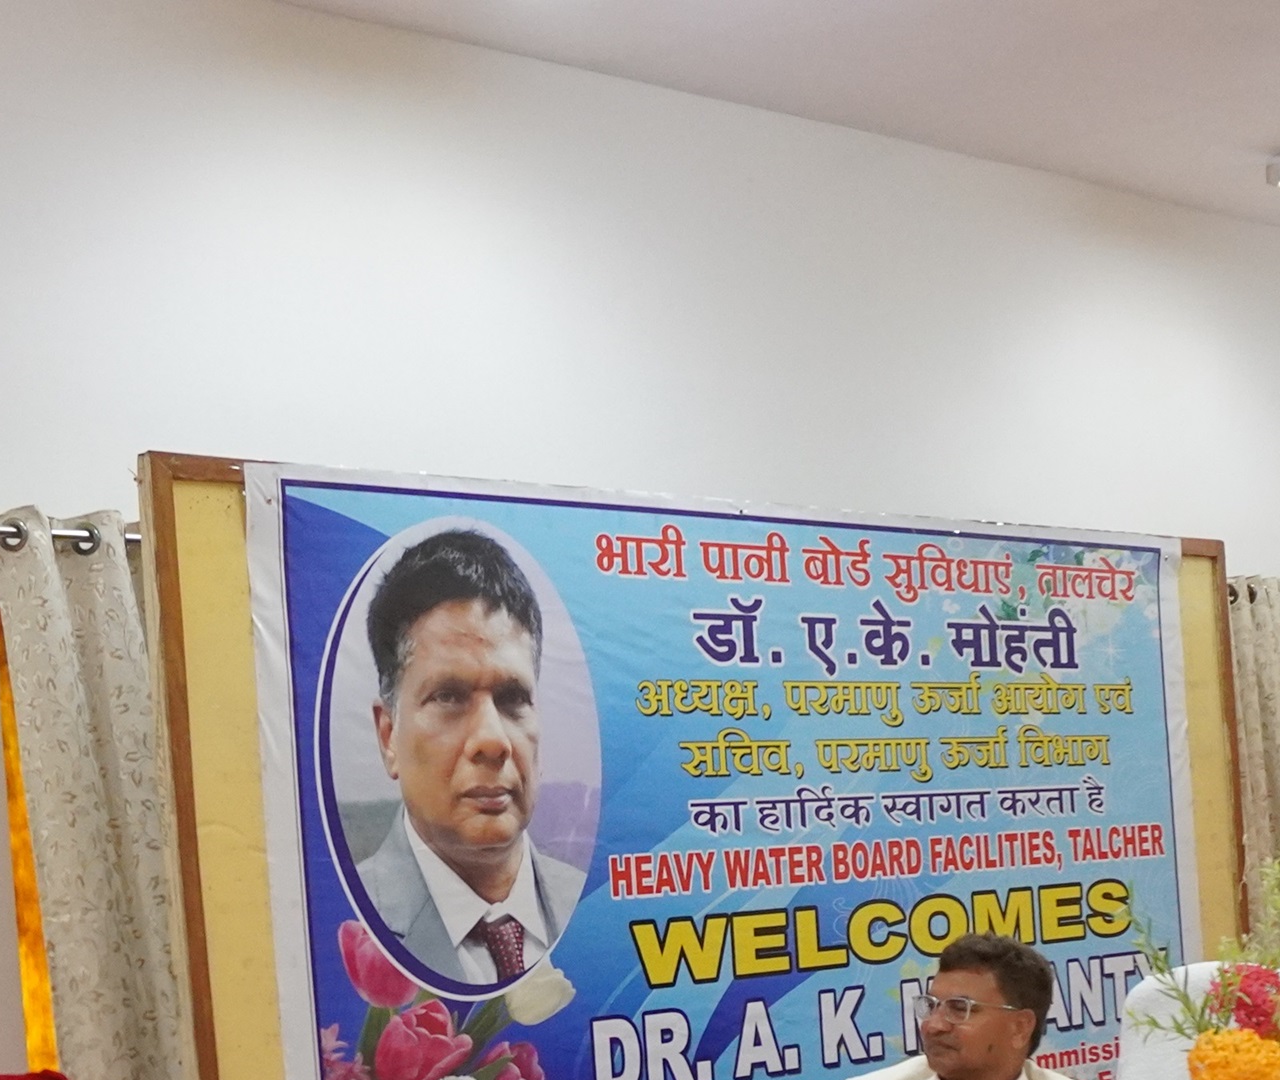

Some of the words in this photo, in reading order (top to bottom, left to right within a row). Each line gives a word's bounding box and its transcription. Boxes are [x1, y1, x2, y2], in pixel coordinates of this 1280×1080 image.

[596, 524, 686, 578] भारी
[700, 532, 789, 583] पानी
[802, 536, 871, 586] बोर्ड
[1036, 557, 1135, 602] तालचेर
[693, 598, 782, 664] डॉ.
[947, 604, 1079, 674] मोहंती
[636, 679, 771, 720] अध्यक्ष,
[783, 680, 904, 727] परमाणु
[911, 672, 981, 715] ऊर्जा
[991, 673, 1087, 714] आयोग
[1094, 676, 1133, 714] एवं
[679, 728, 804, 778] सचिव,
[815, 738, 933, 782] परमाणु
[939, 724, 1009, 770] ऊर्जा
[1018, 724, 1110, 767] विभाग
[690, 801, 748, 834] का
[756, 787, 874, 830] हार्दिक
[882, 790, 991, 824] स्वागत
[998, 787, 1079, 815] करता
[1083, 776, 1104, 814] है
[610, 851, 715, 897] HEAVY
[724, 845, 825, 888] WATER
[833, 838, 922, 881] BOARD
[929, 830, 1063, 873] FACILITIES,
[1068, 823, 1166, 863] TALCHER
[629, 878, 1133, 989] WELCOMES
[818, 984, 885, 1068] K.
